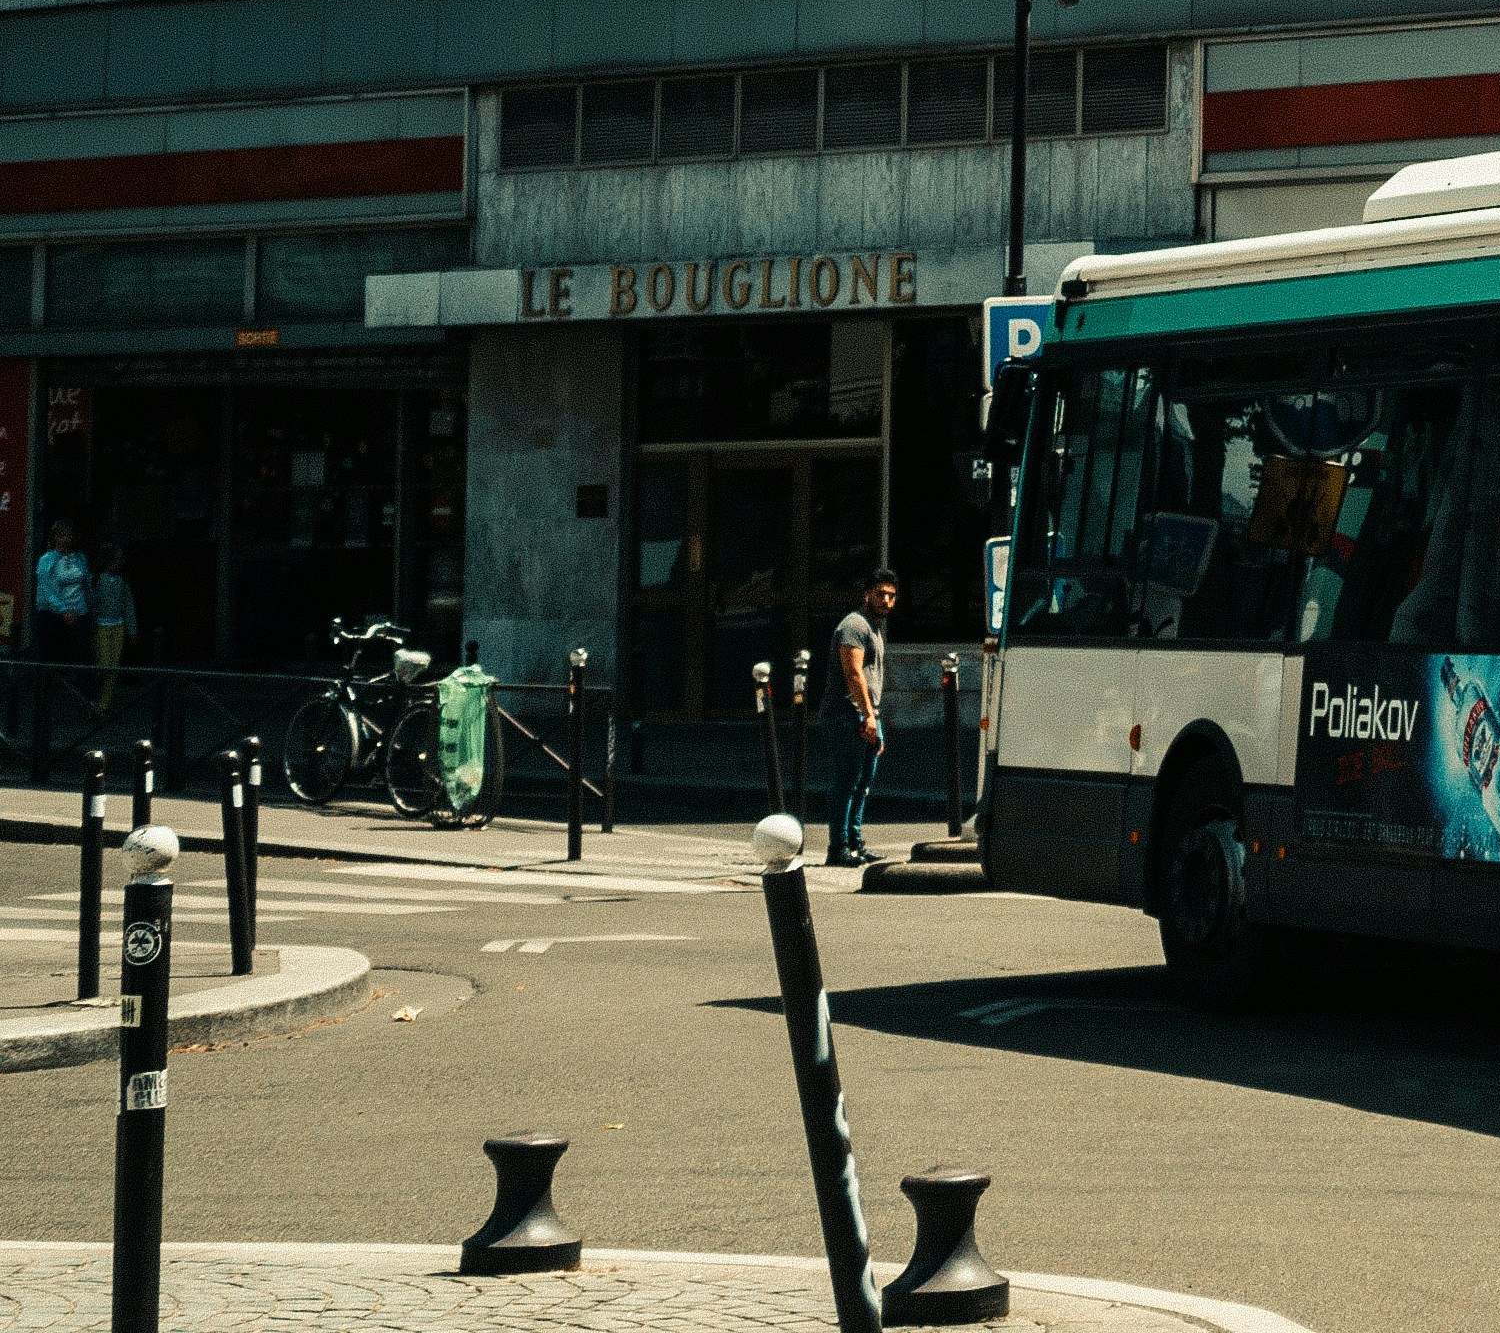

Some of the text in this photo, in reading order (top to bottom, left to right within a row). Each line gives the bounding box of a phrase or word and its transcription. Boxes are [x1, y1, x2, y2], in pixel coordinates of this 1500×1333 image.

[519, 252, 918, 319] LE BOUGLIONE
[1008, 318, 1042, 358] P
[1309, 682, 1420, 742] Poliakov
